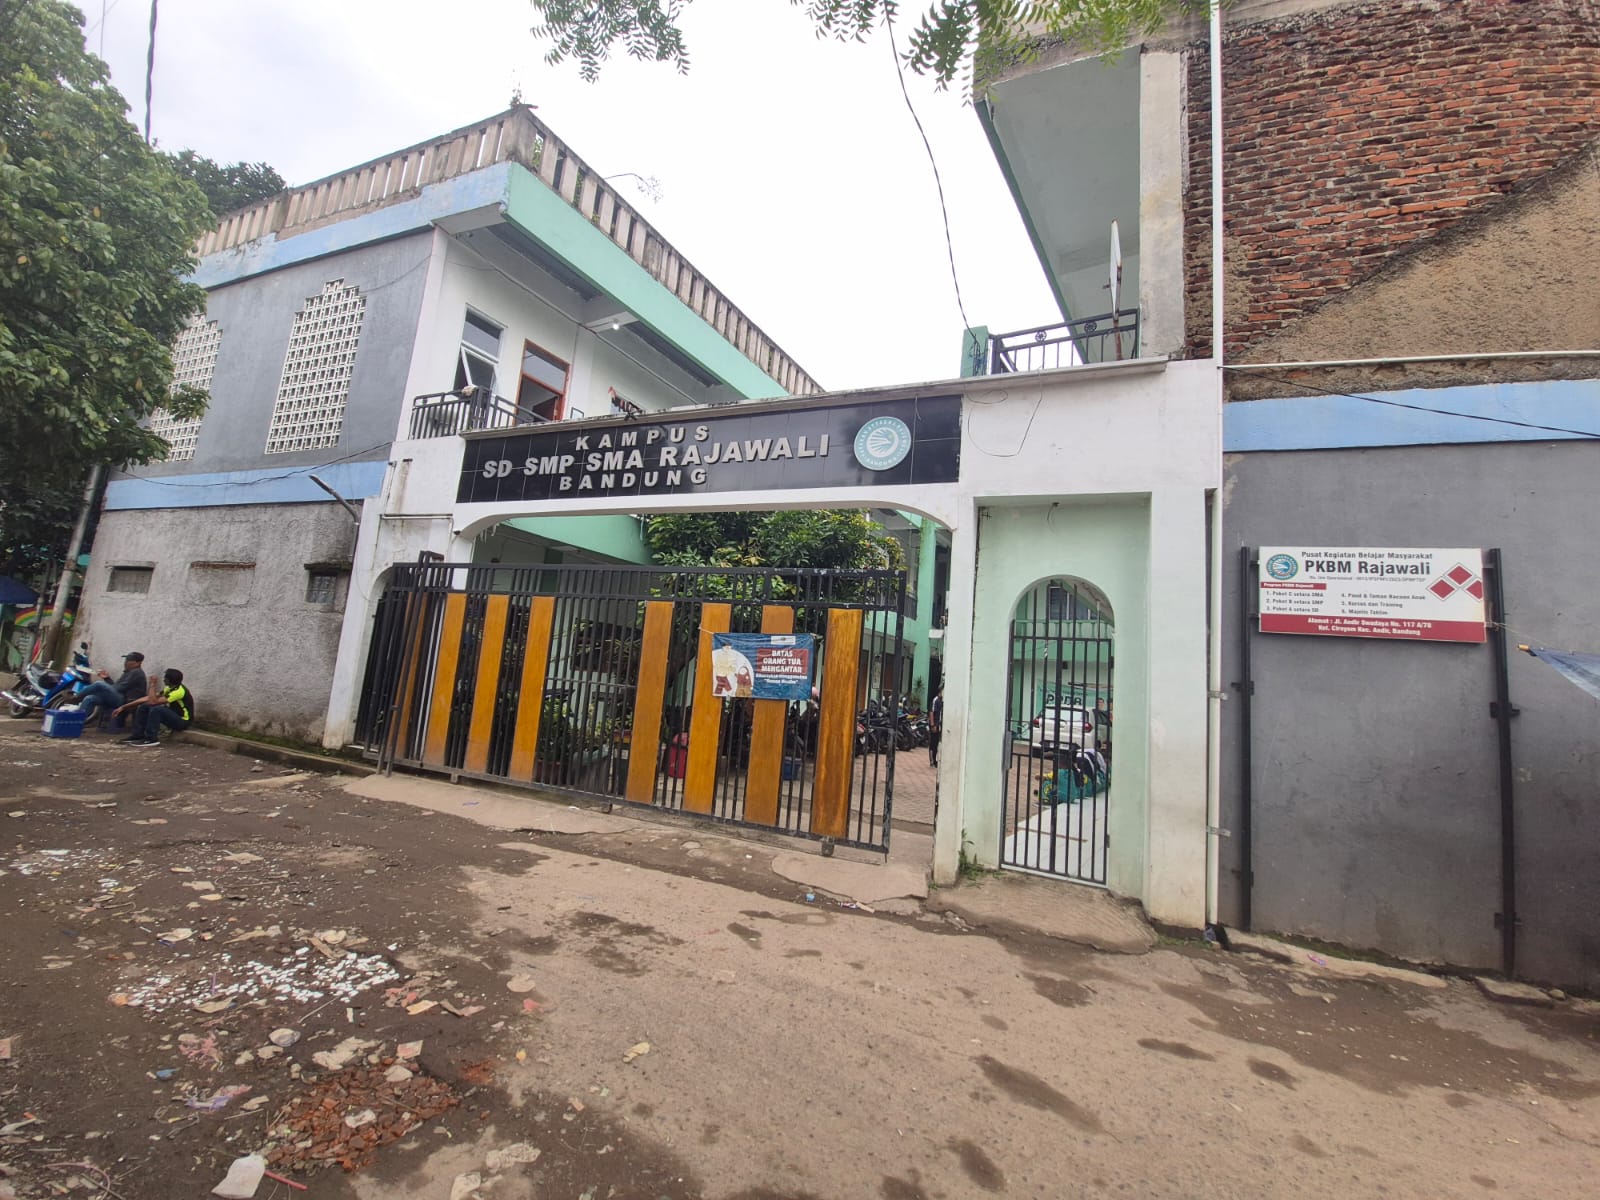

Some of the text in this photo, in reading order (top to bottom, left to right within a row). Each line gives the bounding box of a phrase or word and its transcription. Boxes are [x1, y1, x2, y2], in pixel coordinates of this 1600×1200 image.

[575, 425, 709, 451] KAMPUS
[482, 459, 513, 478] SD
[523, 454, 575, 475] SMP
[586, 449, 644, 471] SMA
[659, 433, 829, 467] RAJAWALI
[559, 468, 708, 491] BANDUNG
[1305, 560, 1351, 573] PKBM
[1358, 560, 1430, 576] Rajawali
[761, 665, 803, 673] MENGANTAR
